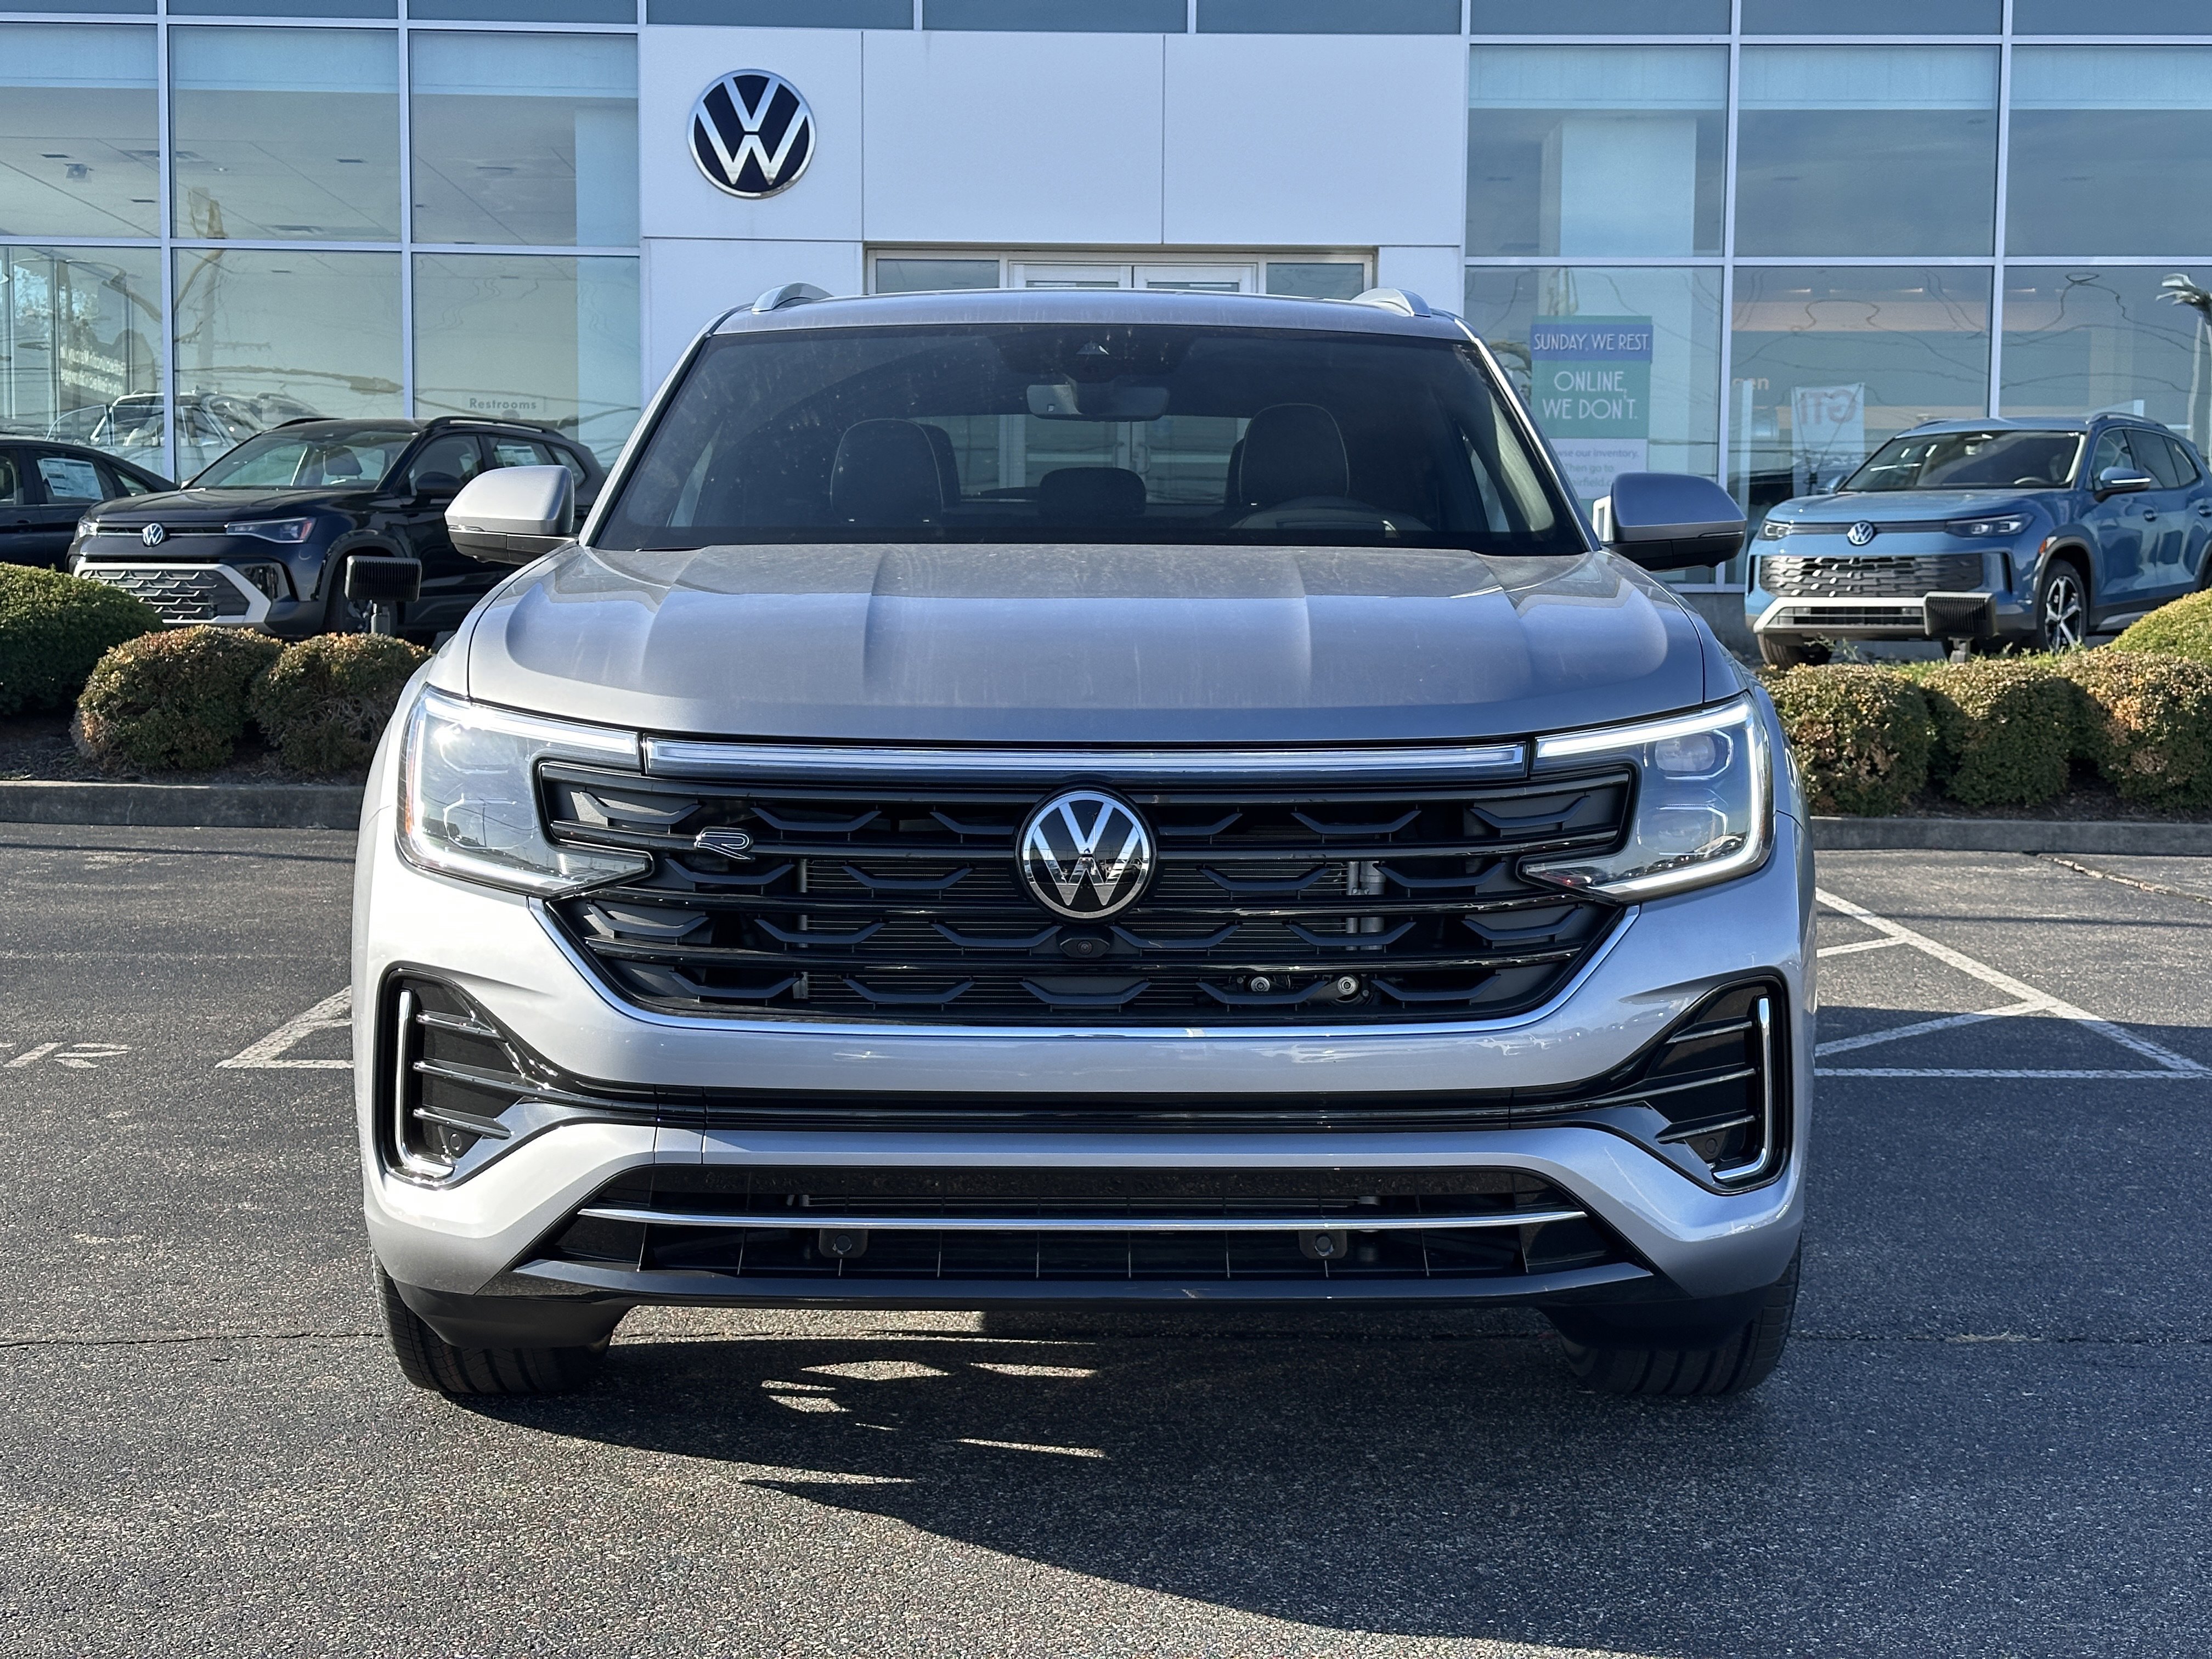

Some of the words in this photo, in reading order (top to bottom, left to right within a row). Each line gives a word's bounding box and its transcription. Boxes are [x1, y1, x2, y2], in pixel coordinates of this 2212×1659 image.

[1534, 334, 1589, 352] SUNDAY,
[1591, 334, 1615, 351] WE
[1618, 334, 1650, 351] REST.
[1554, 370, 1627, 393] ONLINE,
[469, 398, 537, 409] Restrooms
[1542, 398, 1572, 419] WE
[1578, 397, 1638, 419] DON'T.
[1589, 465, 1602, 474] go
[1605, 464, 1615, 472] to
